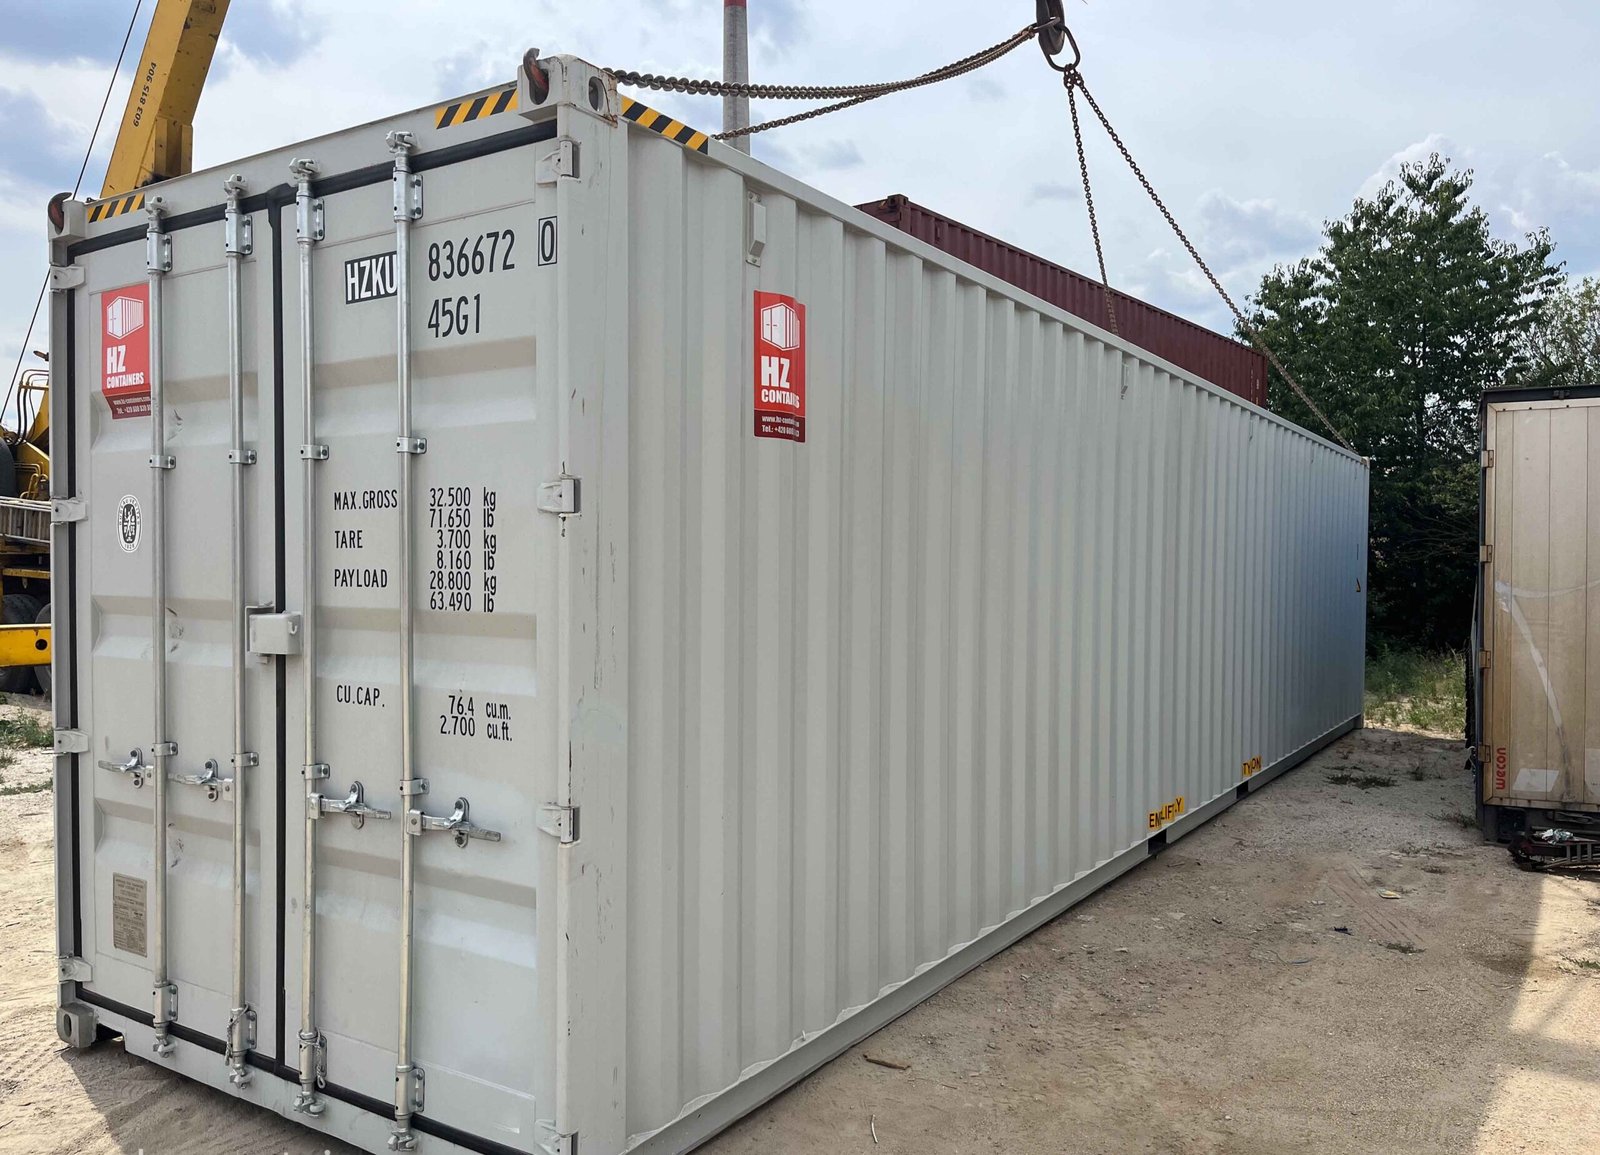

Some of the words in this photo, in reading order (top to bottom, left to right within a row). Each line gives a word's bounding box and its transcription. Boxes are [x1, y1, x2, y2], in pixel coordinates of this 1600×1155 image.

[133, 106, 143, 127] 603
[140, 84, 150, 105] 815
[146, 62, 157, 83] 904
[346, 254, 398, 301] HZKU
[428, 229, 515, 281] 836672
[540, 220, 555, 262] 0
[427, 293, 481, 338] 45G1
[106, 345, 126, 374] HZ
[761, 355, 790, 389] HZ
[106, 372, 144, 389] CONTAINERS
[334, 490, 398, 510] MAX.GROSS
[429, 487, 471, 507] 32,500
[483, 487, 497, 511] kg
[429, 508, 471, 528] 71,650
[483, 509, 494, 528] lb
[334, 530, 363, 549] TARE
[436, 529, 471, 549] 3,700
[483, 530, 497, 554] kg
[436, 550, 472, 570] 8,160
[483, 551, 495, 570] lb
[334, 569, 388, 588] PAYLOAD
[429, 571, 472, 591] 28,800
[483, 572, 497, 596] kg
[430, 591, 472, 612] 63,490
[483, 593, 495, 613] lb
[336, 685, 385, 708] CU.CAP.
[448, 695, 475, 716] 76.4
[485, 702, 512, 720] cu.m.
[440, 715, 476, 737] 2,700
[486, 721, 513, 742] cu.ft.
[1496, 747, 1506, 790] wecon
